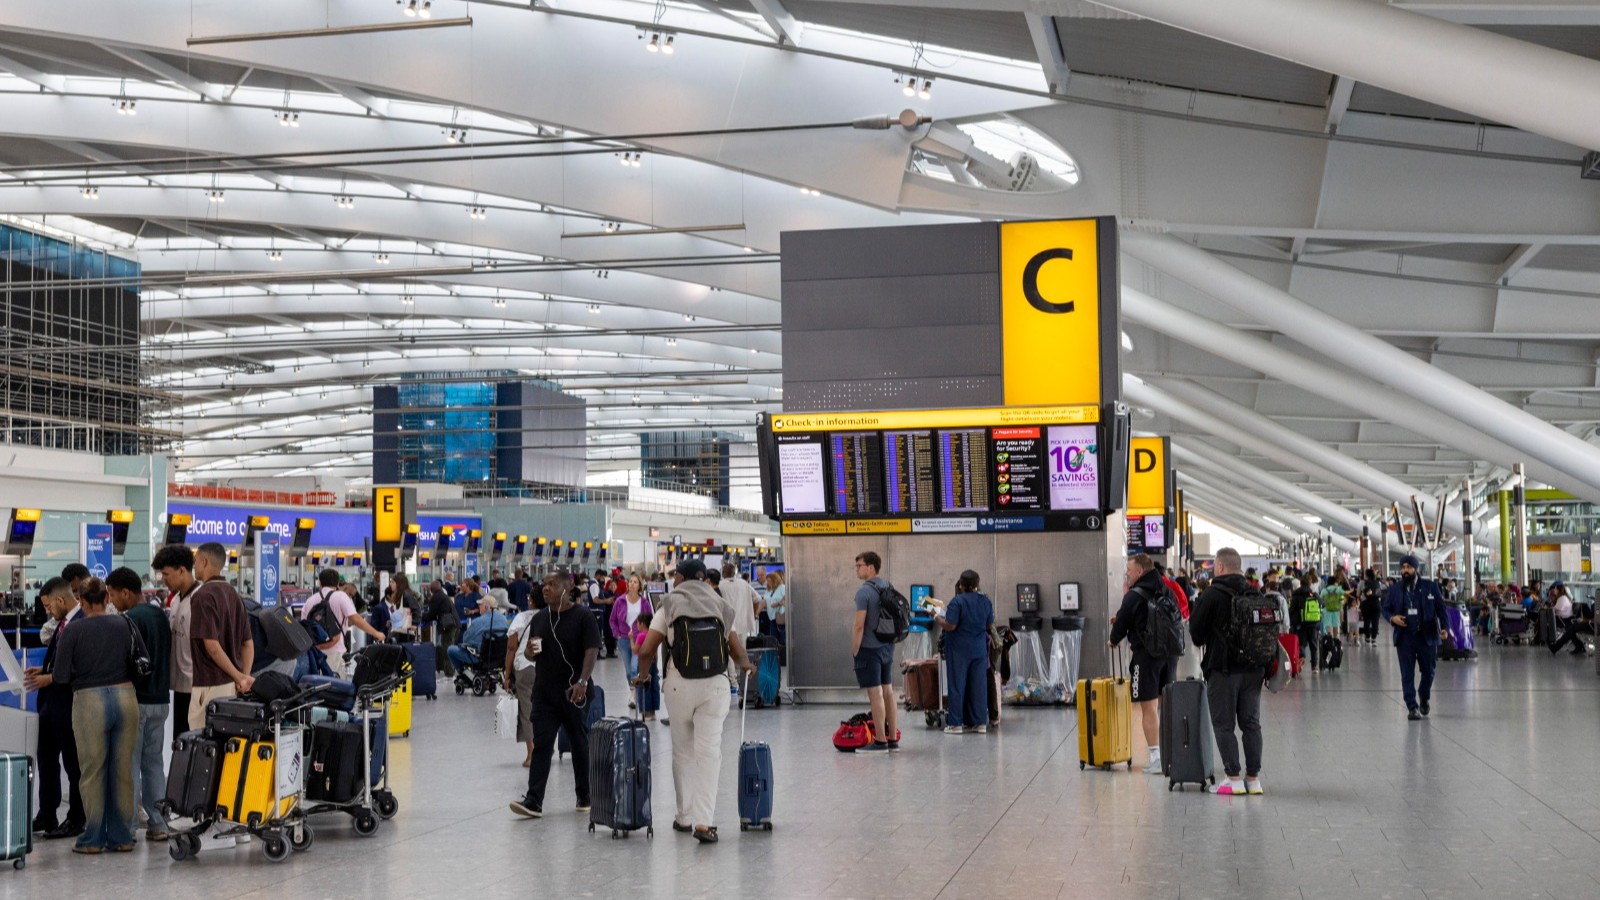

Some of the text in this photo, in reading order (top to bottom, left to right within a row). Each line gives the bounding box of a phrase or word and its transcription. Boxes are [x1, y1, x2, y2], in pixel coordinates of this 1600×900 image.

[1022, 248, 1075, 314] C
[1134, 448, 1156, 473] D
[1052, 473, 1096, 482] SAVINGS
[383, 495, 394, 512] E
[187, 514, 222, 535] elcome
[226, 519, 236, 536] to
[265, 522, 292, 537] ome.
[1146, 522, 1158, 533] 10
